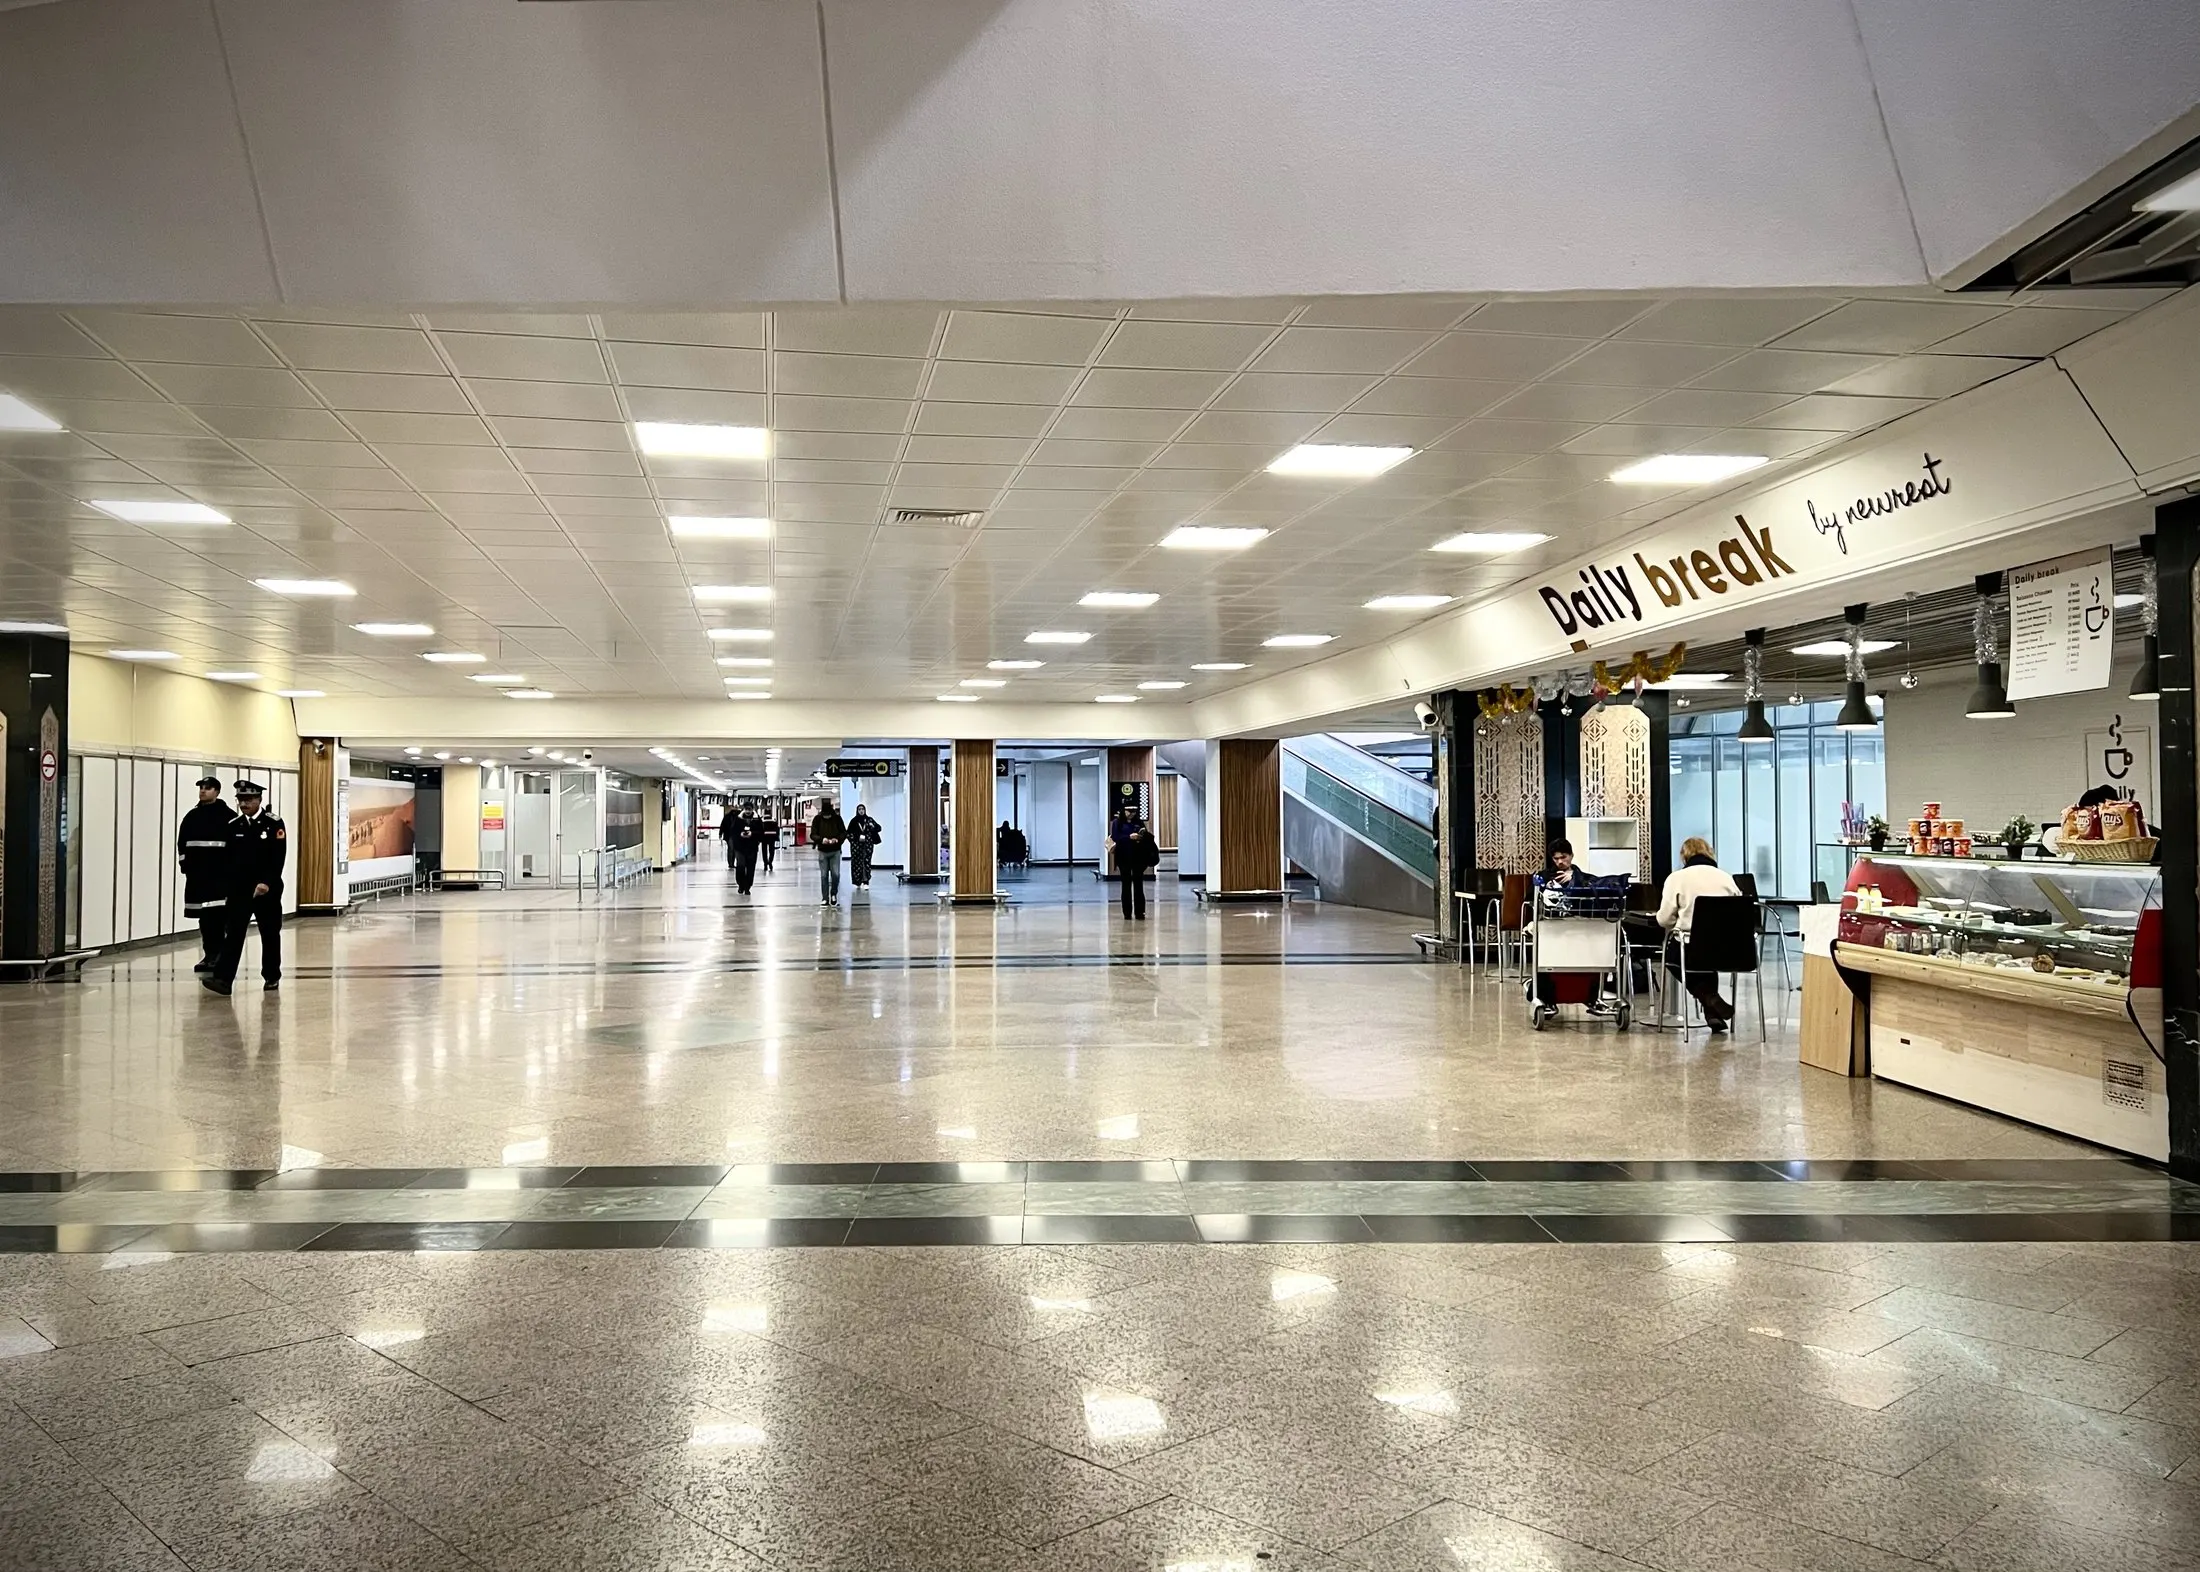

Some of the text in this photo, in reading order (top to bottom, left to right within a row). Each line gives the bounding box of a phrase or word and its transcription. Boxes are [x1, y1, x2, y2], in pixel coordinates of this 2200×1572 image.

[1538, 452, 1953, 637] Daily break by newrest
[2015, 566, 2059, 585] Daily break
